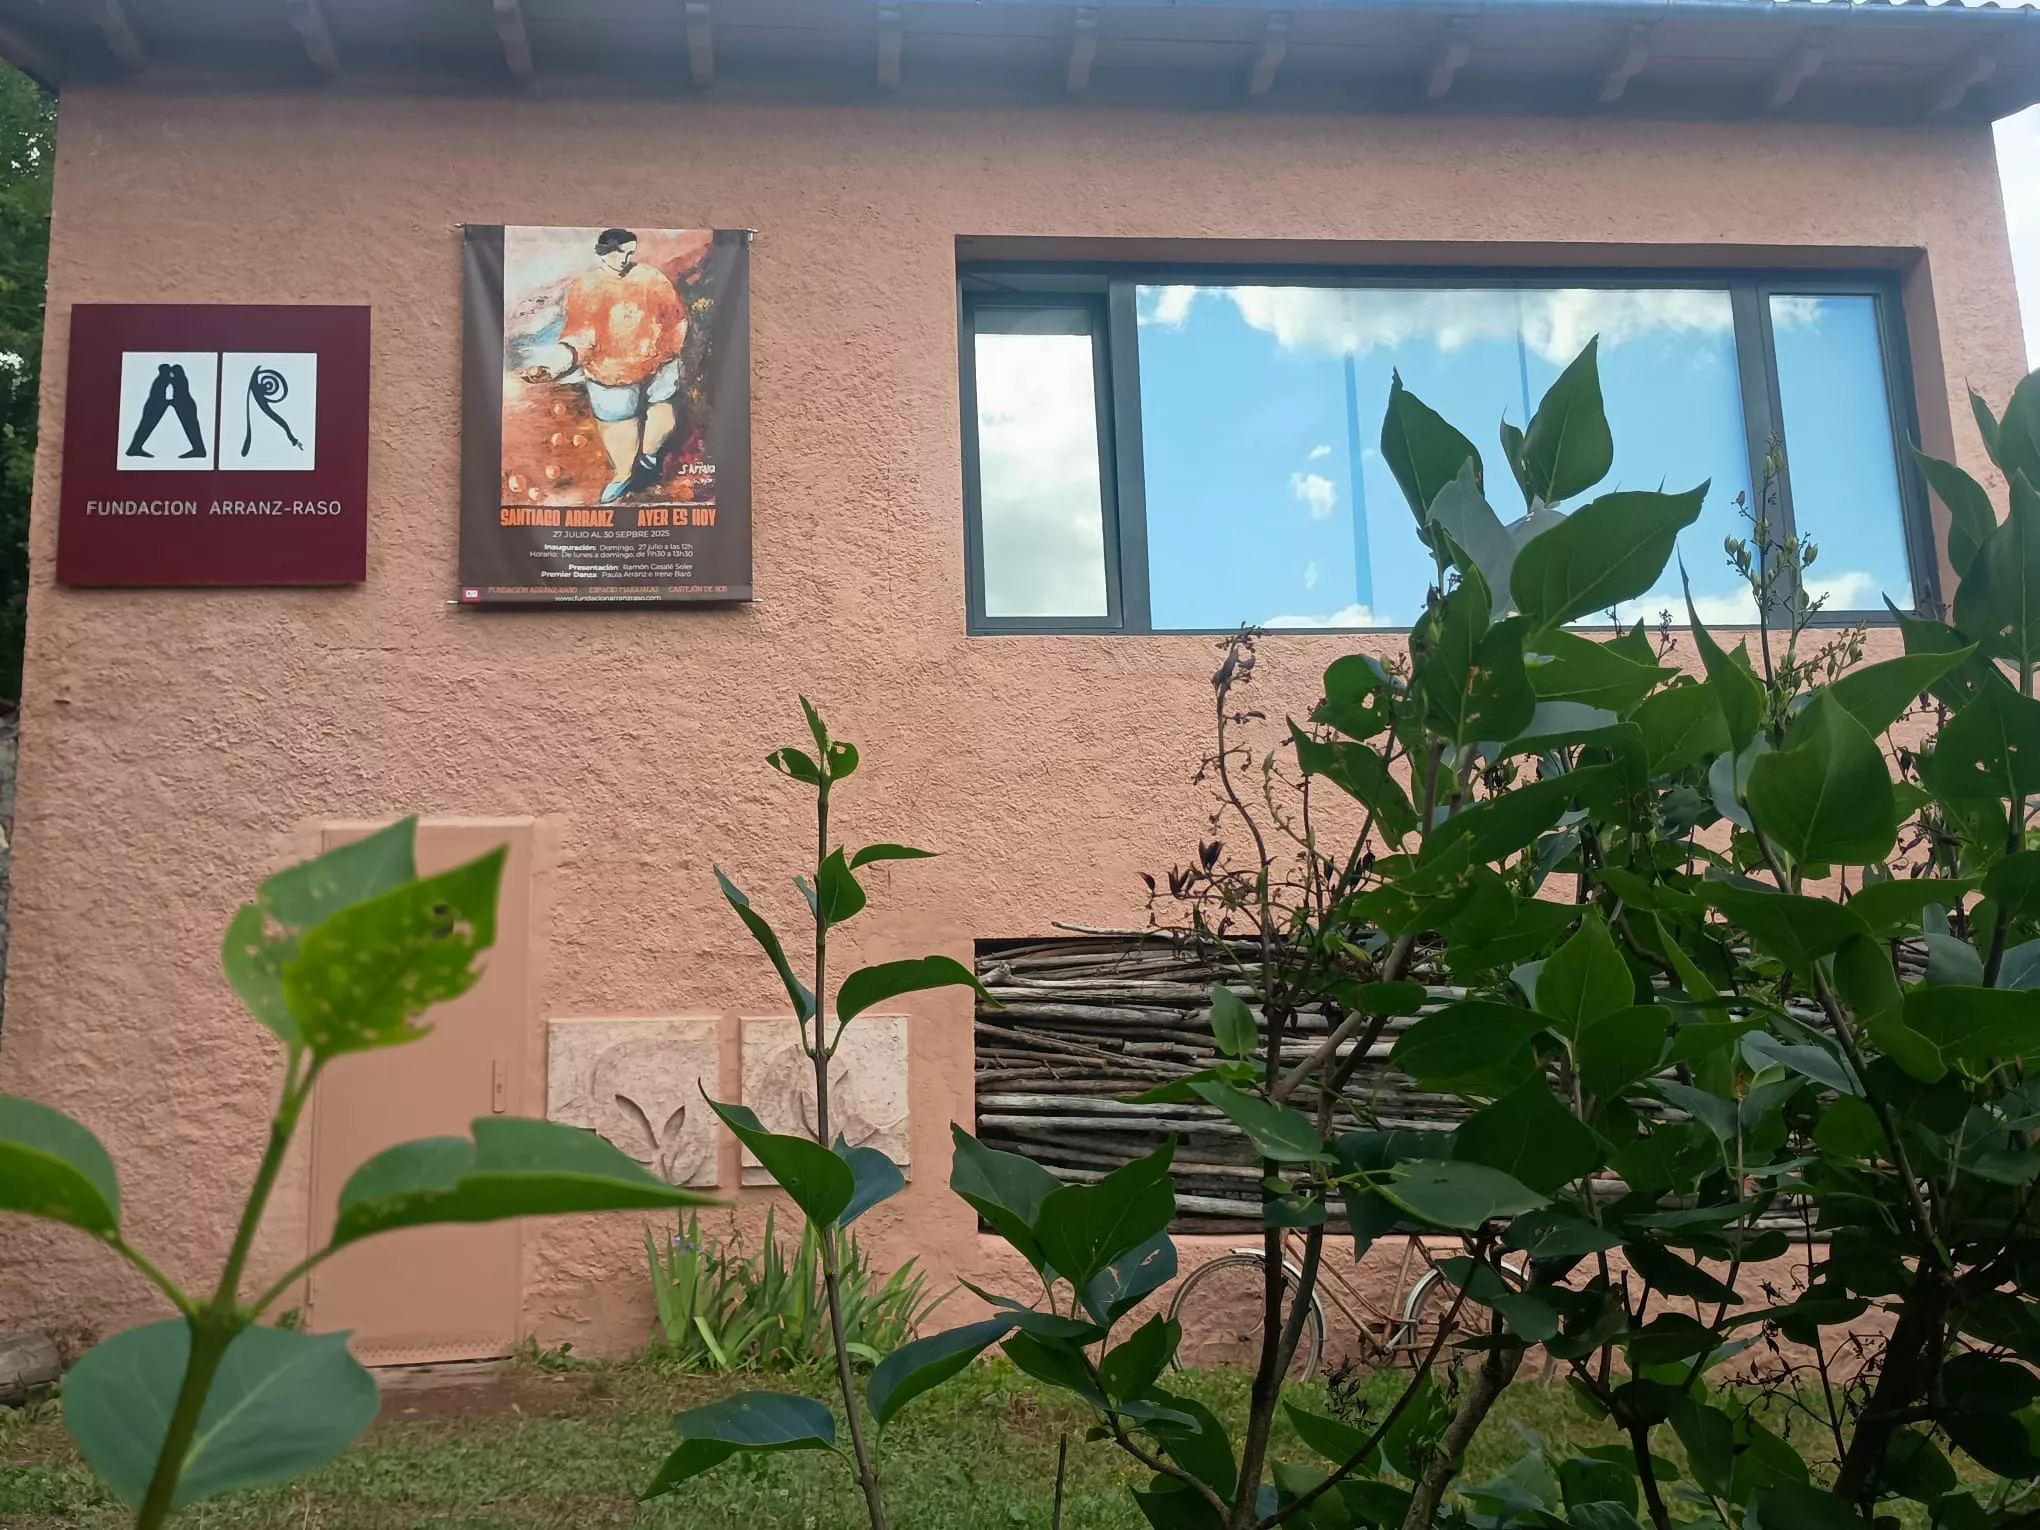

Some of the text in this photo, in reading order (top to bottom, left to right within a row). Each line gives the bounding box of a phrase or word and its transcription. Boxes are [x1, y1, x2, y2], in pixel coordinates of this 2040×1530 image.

[86, 500, 342, 516] FUNDACION ARRANZ-RASO
[500, 508, 717, 528] SANTIAGO ARRANZ AYER ES HOY
[564, 531, 590, 539] JULIO
[604, 530, 614, 538] 30
[615, 530, 649, 538] SEPBRE
[651, 529, 671, 538] 2025
[638, 543, 648, 551] 27
[648, 543, 663, 552] julio
[623, 563, 649, 571] Ramón
